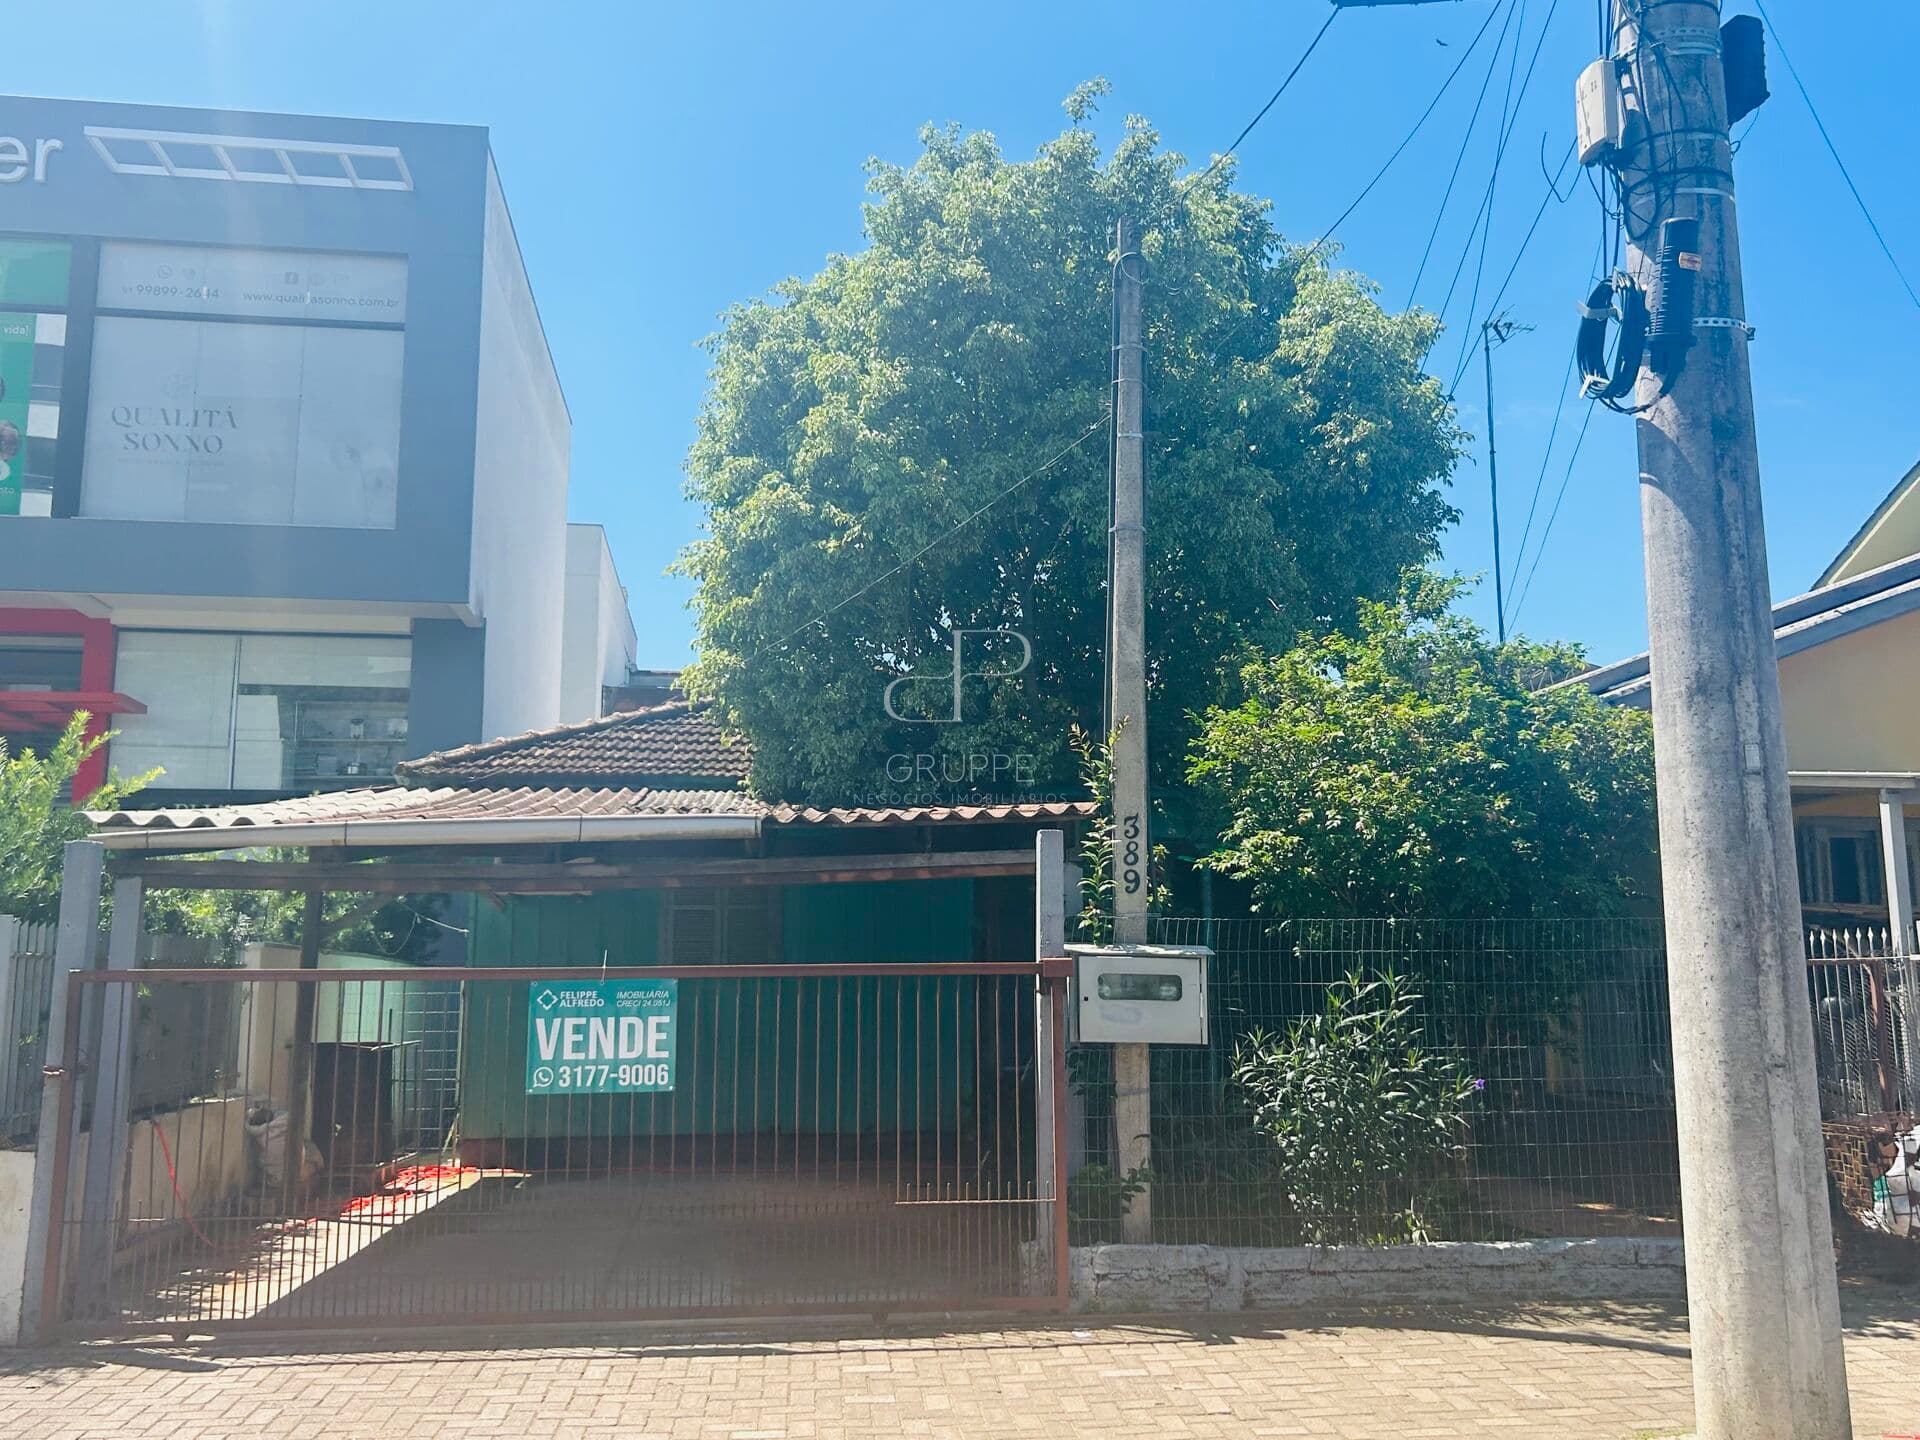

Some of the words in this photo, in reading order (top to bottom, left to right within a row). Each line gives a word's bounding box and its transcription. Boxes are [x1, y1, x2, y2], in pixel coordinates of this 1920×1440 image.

[0, 136, 64, 184] er
[242, 291, 399, 308] www.qualiasonno.com.br
[123, 432, 224, 454] SONNO
[1123, 812, 1141, 895] 389
[559, 999, 605, 1008] ALFREDO
[560, 990, 598, 999] FELIPPE
[616, 999, 641, 1008] CRECI
[535, 1015, 670, 1061] VENDE
[558, 1064, 669, 1088] 3177-9006
